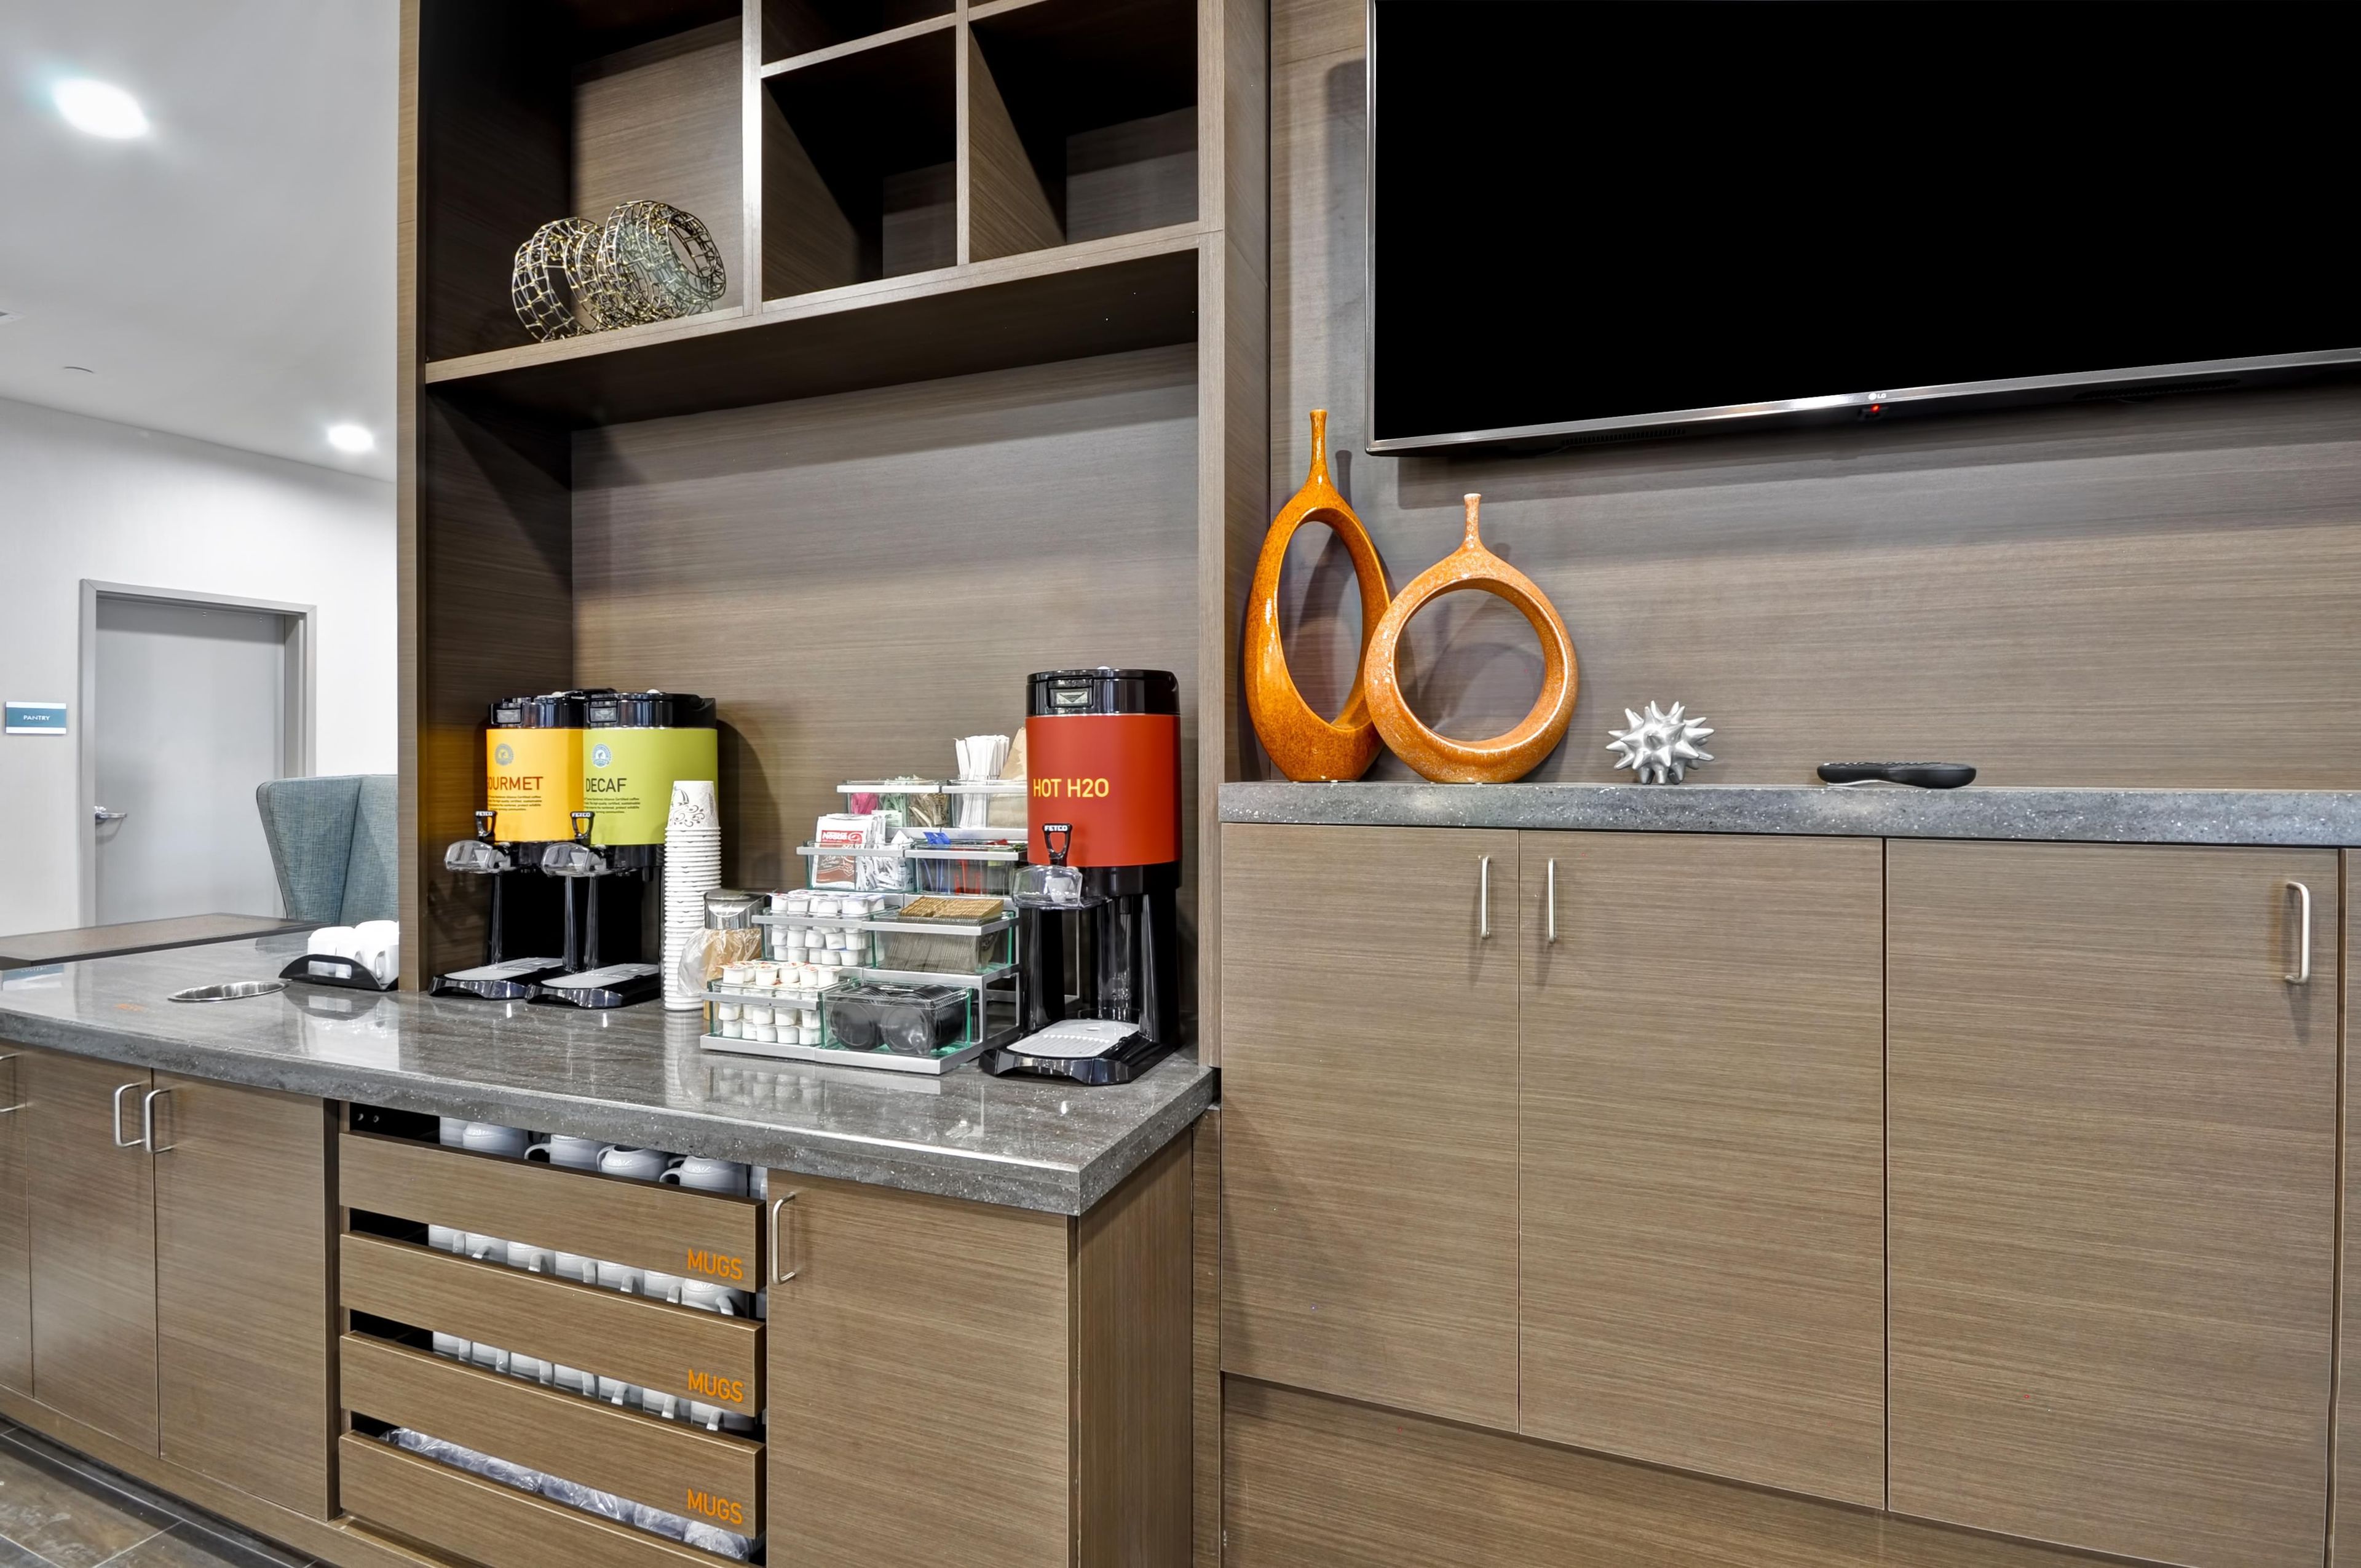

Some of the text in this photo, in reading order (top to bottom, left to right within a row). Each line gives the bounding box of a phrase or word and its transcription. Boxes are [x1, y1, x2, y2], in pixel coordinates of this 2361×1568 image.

[586, 778, 627, 792] DECAF
[1033, 778, 1109, 797] HOT H2O
[687, 1249, 743, 1280] MUGS
[688, 1369, 743, 1403] MUGS
[687, 1489, 743, 1524] MUGS
